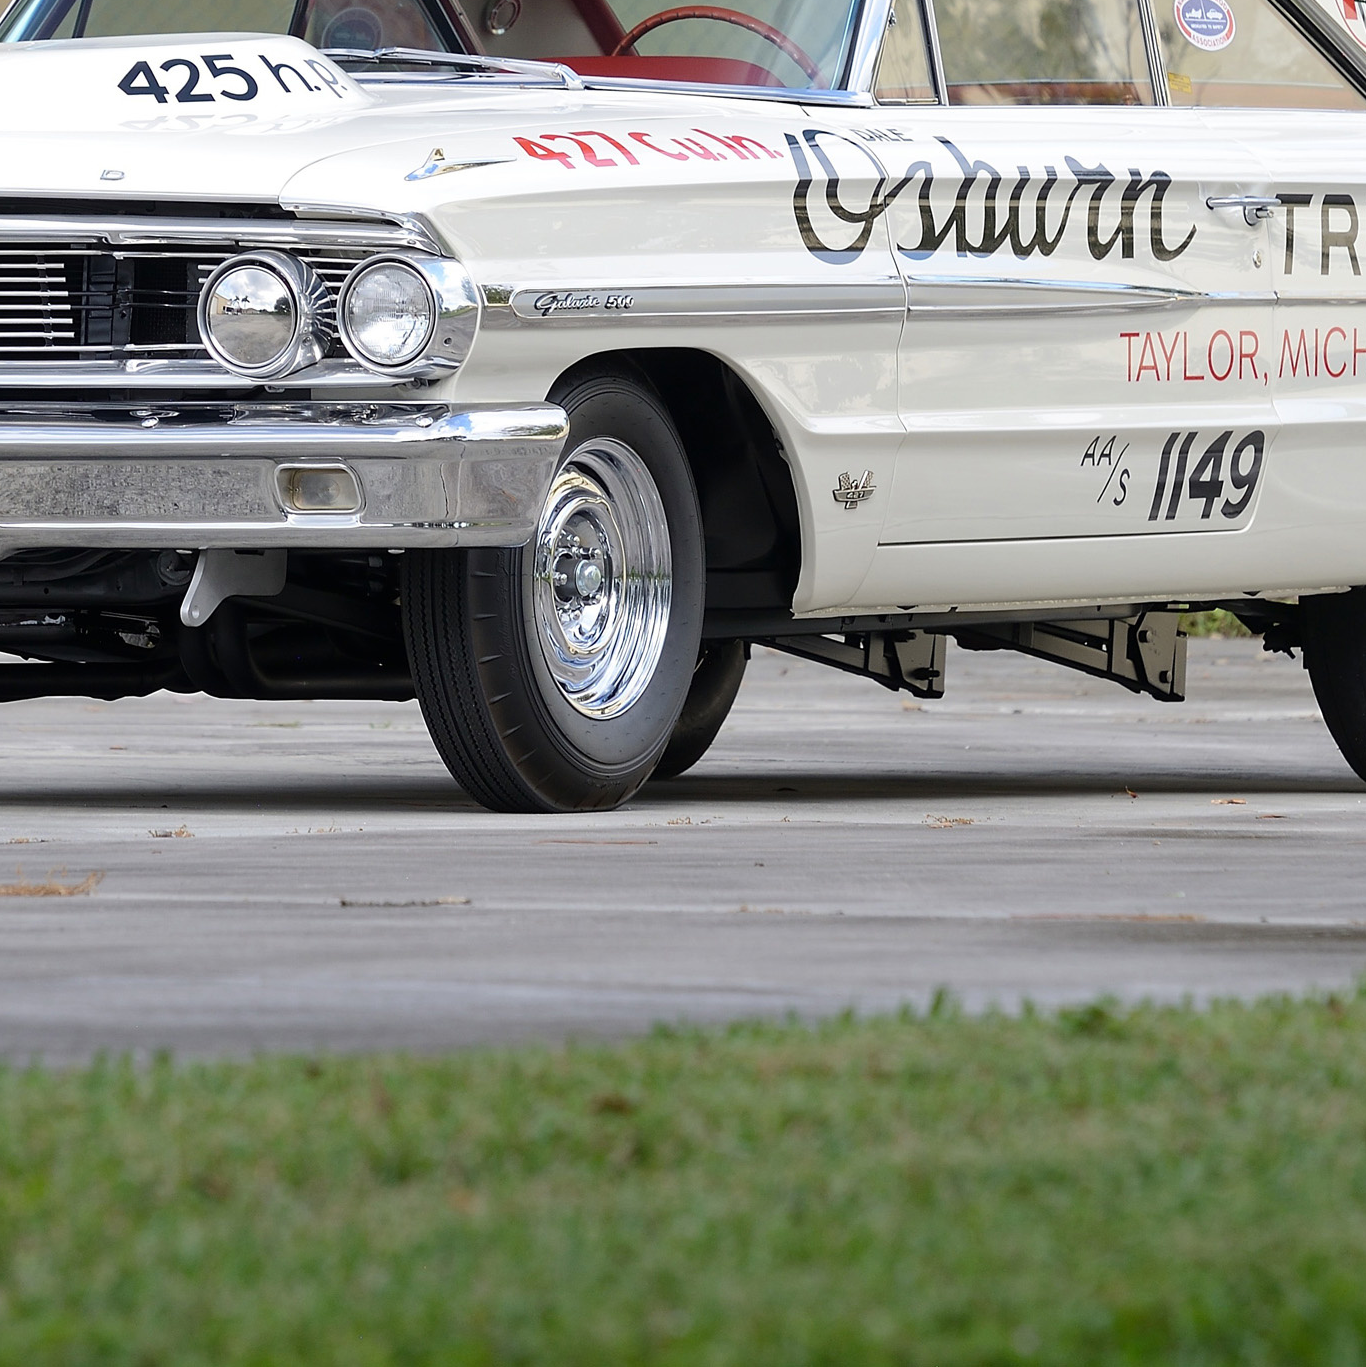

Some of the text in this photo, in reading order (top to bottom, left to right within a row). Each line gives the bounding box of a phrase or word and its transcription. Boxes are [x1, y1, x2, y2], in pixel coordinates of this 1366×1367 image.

[117, 54, 348, 103] 425 h.p.
[513, 131, 640, 169] 427
[849, 128, 914, 142] DALE
[784, 129, 1197, 265] Osburn
[534, 291, 635, 317] Galaxie 500
[1120, 329, 1269, 387] TAYLOR,
[1148, 430, 1266, 522] 1149
